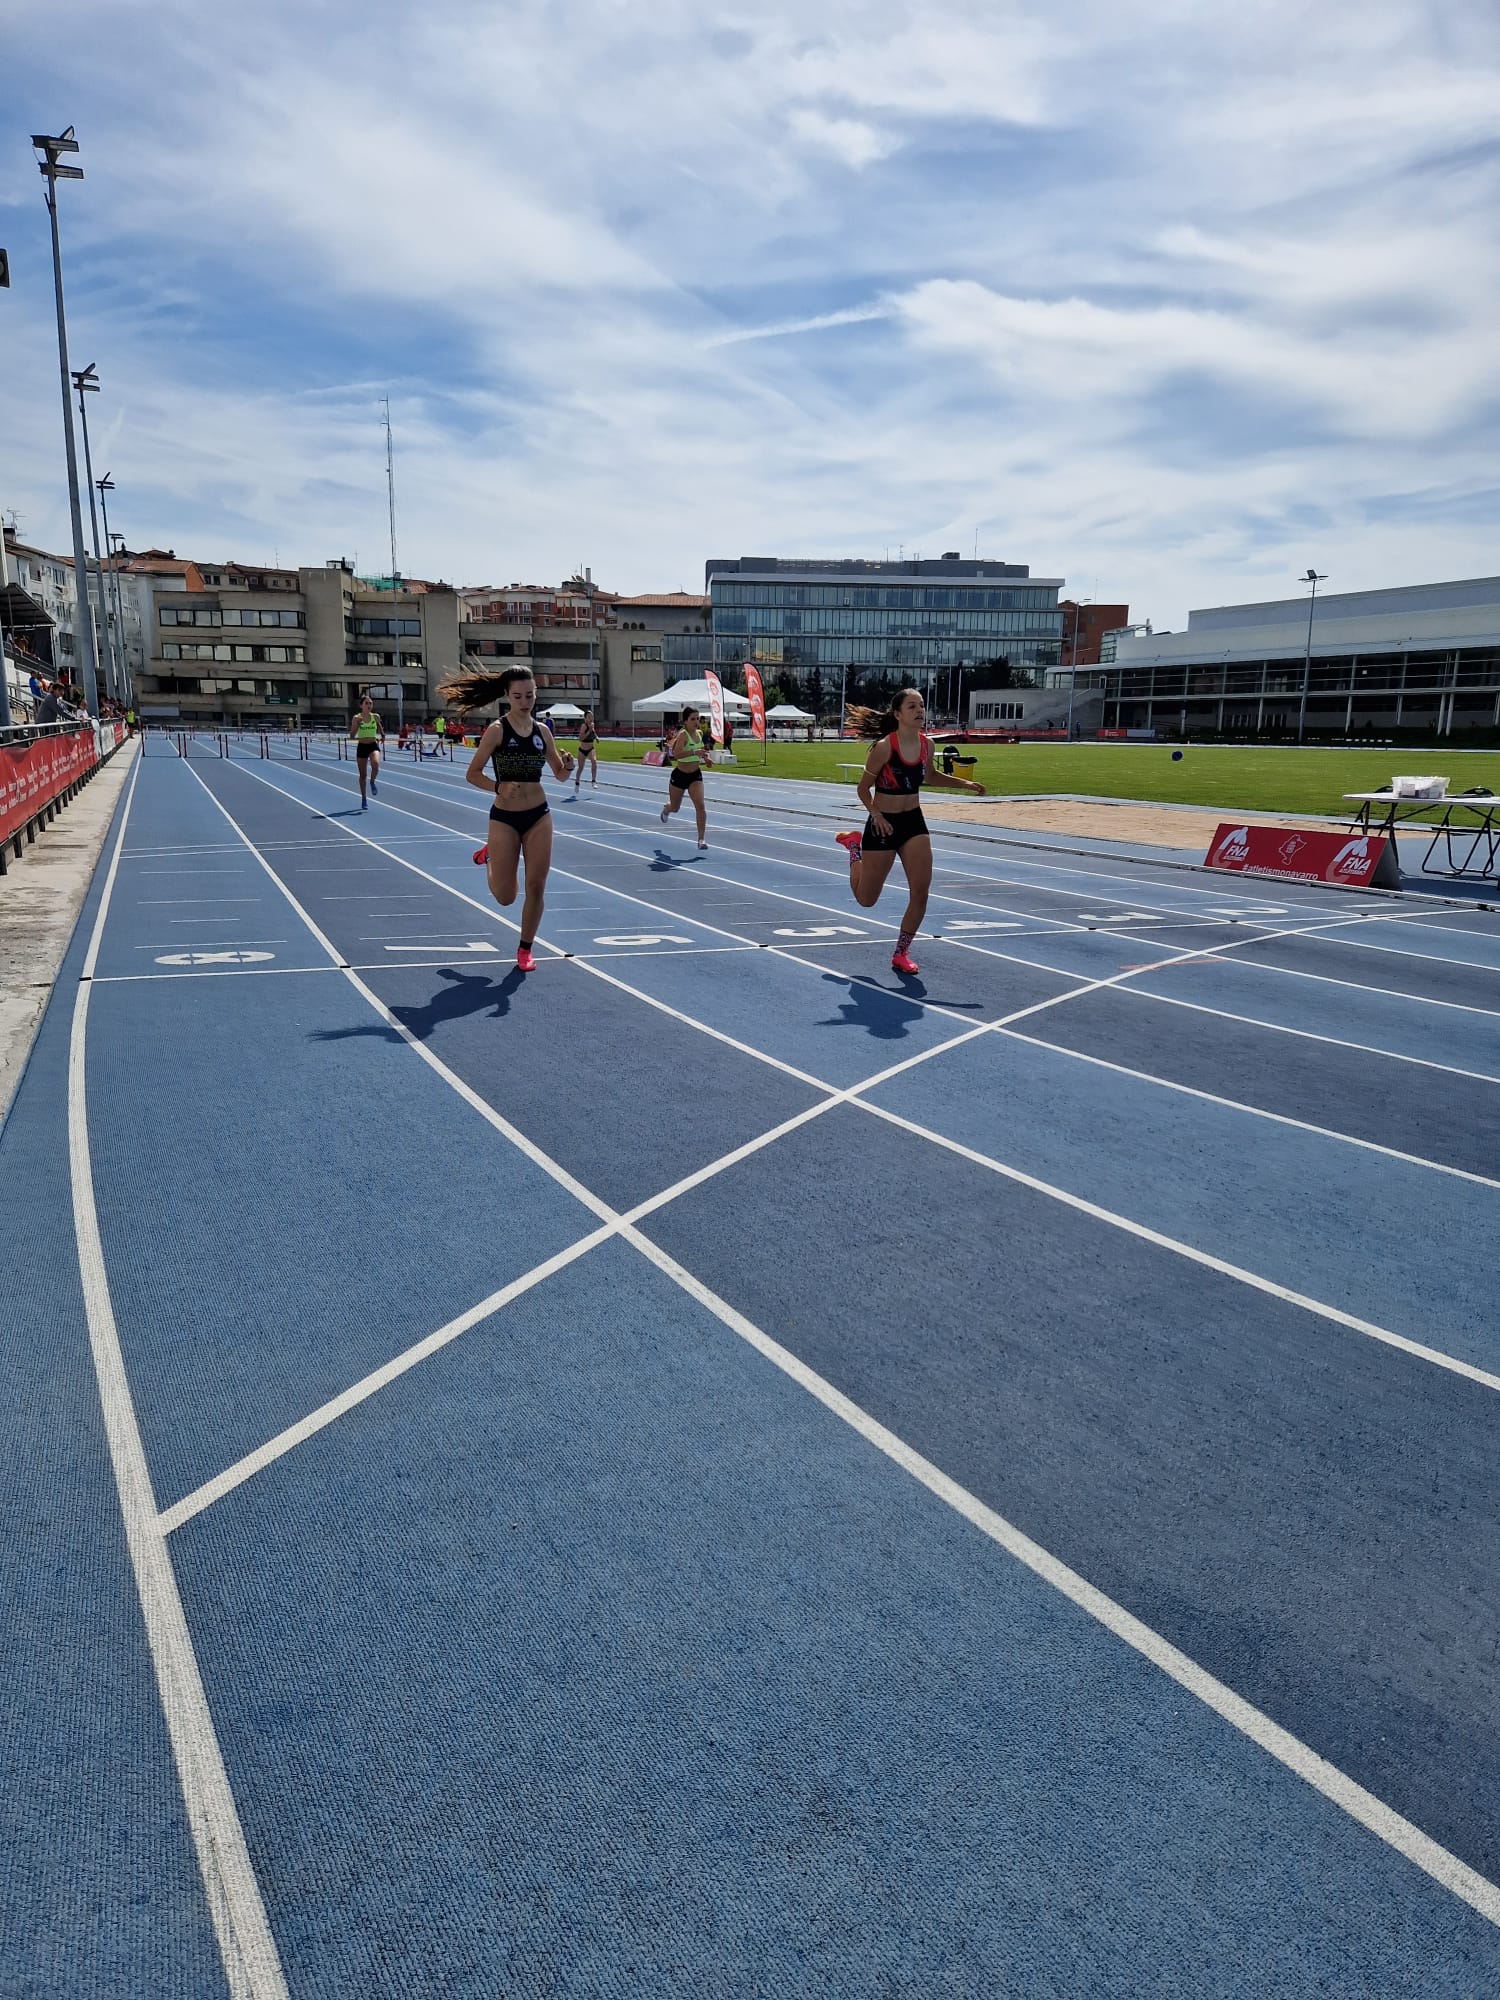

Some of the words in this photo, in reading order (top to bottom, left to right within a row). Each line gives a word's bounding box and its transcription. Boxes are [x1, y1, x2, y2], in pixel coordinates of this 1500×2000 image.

[1225, 845, 1250, 857] FNA
[1342, 856, 1372, 871] FNA
[1242, 863, 1319, 881] #atletismonavarro
[1202, 905, 1289, 916] 2
[1077, 911, 1167, 922] 3
[942, 920, 1026, 930] 4
[772, 926, 870, 937] 5
[593, 934, 696, 946] 6
[384, 941, 500, 952] 7
[155, 950, 275, 965] 8
